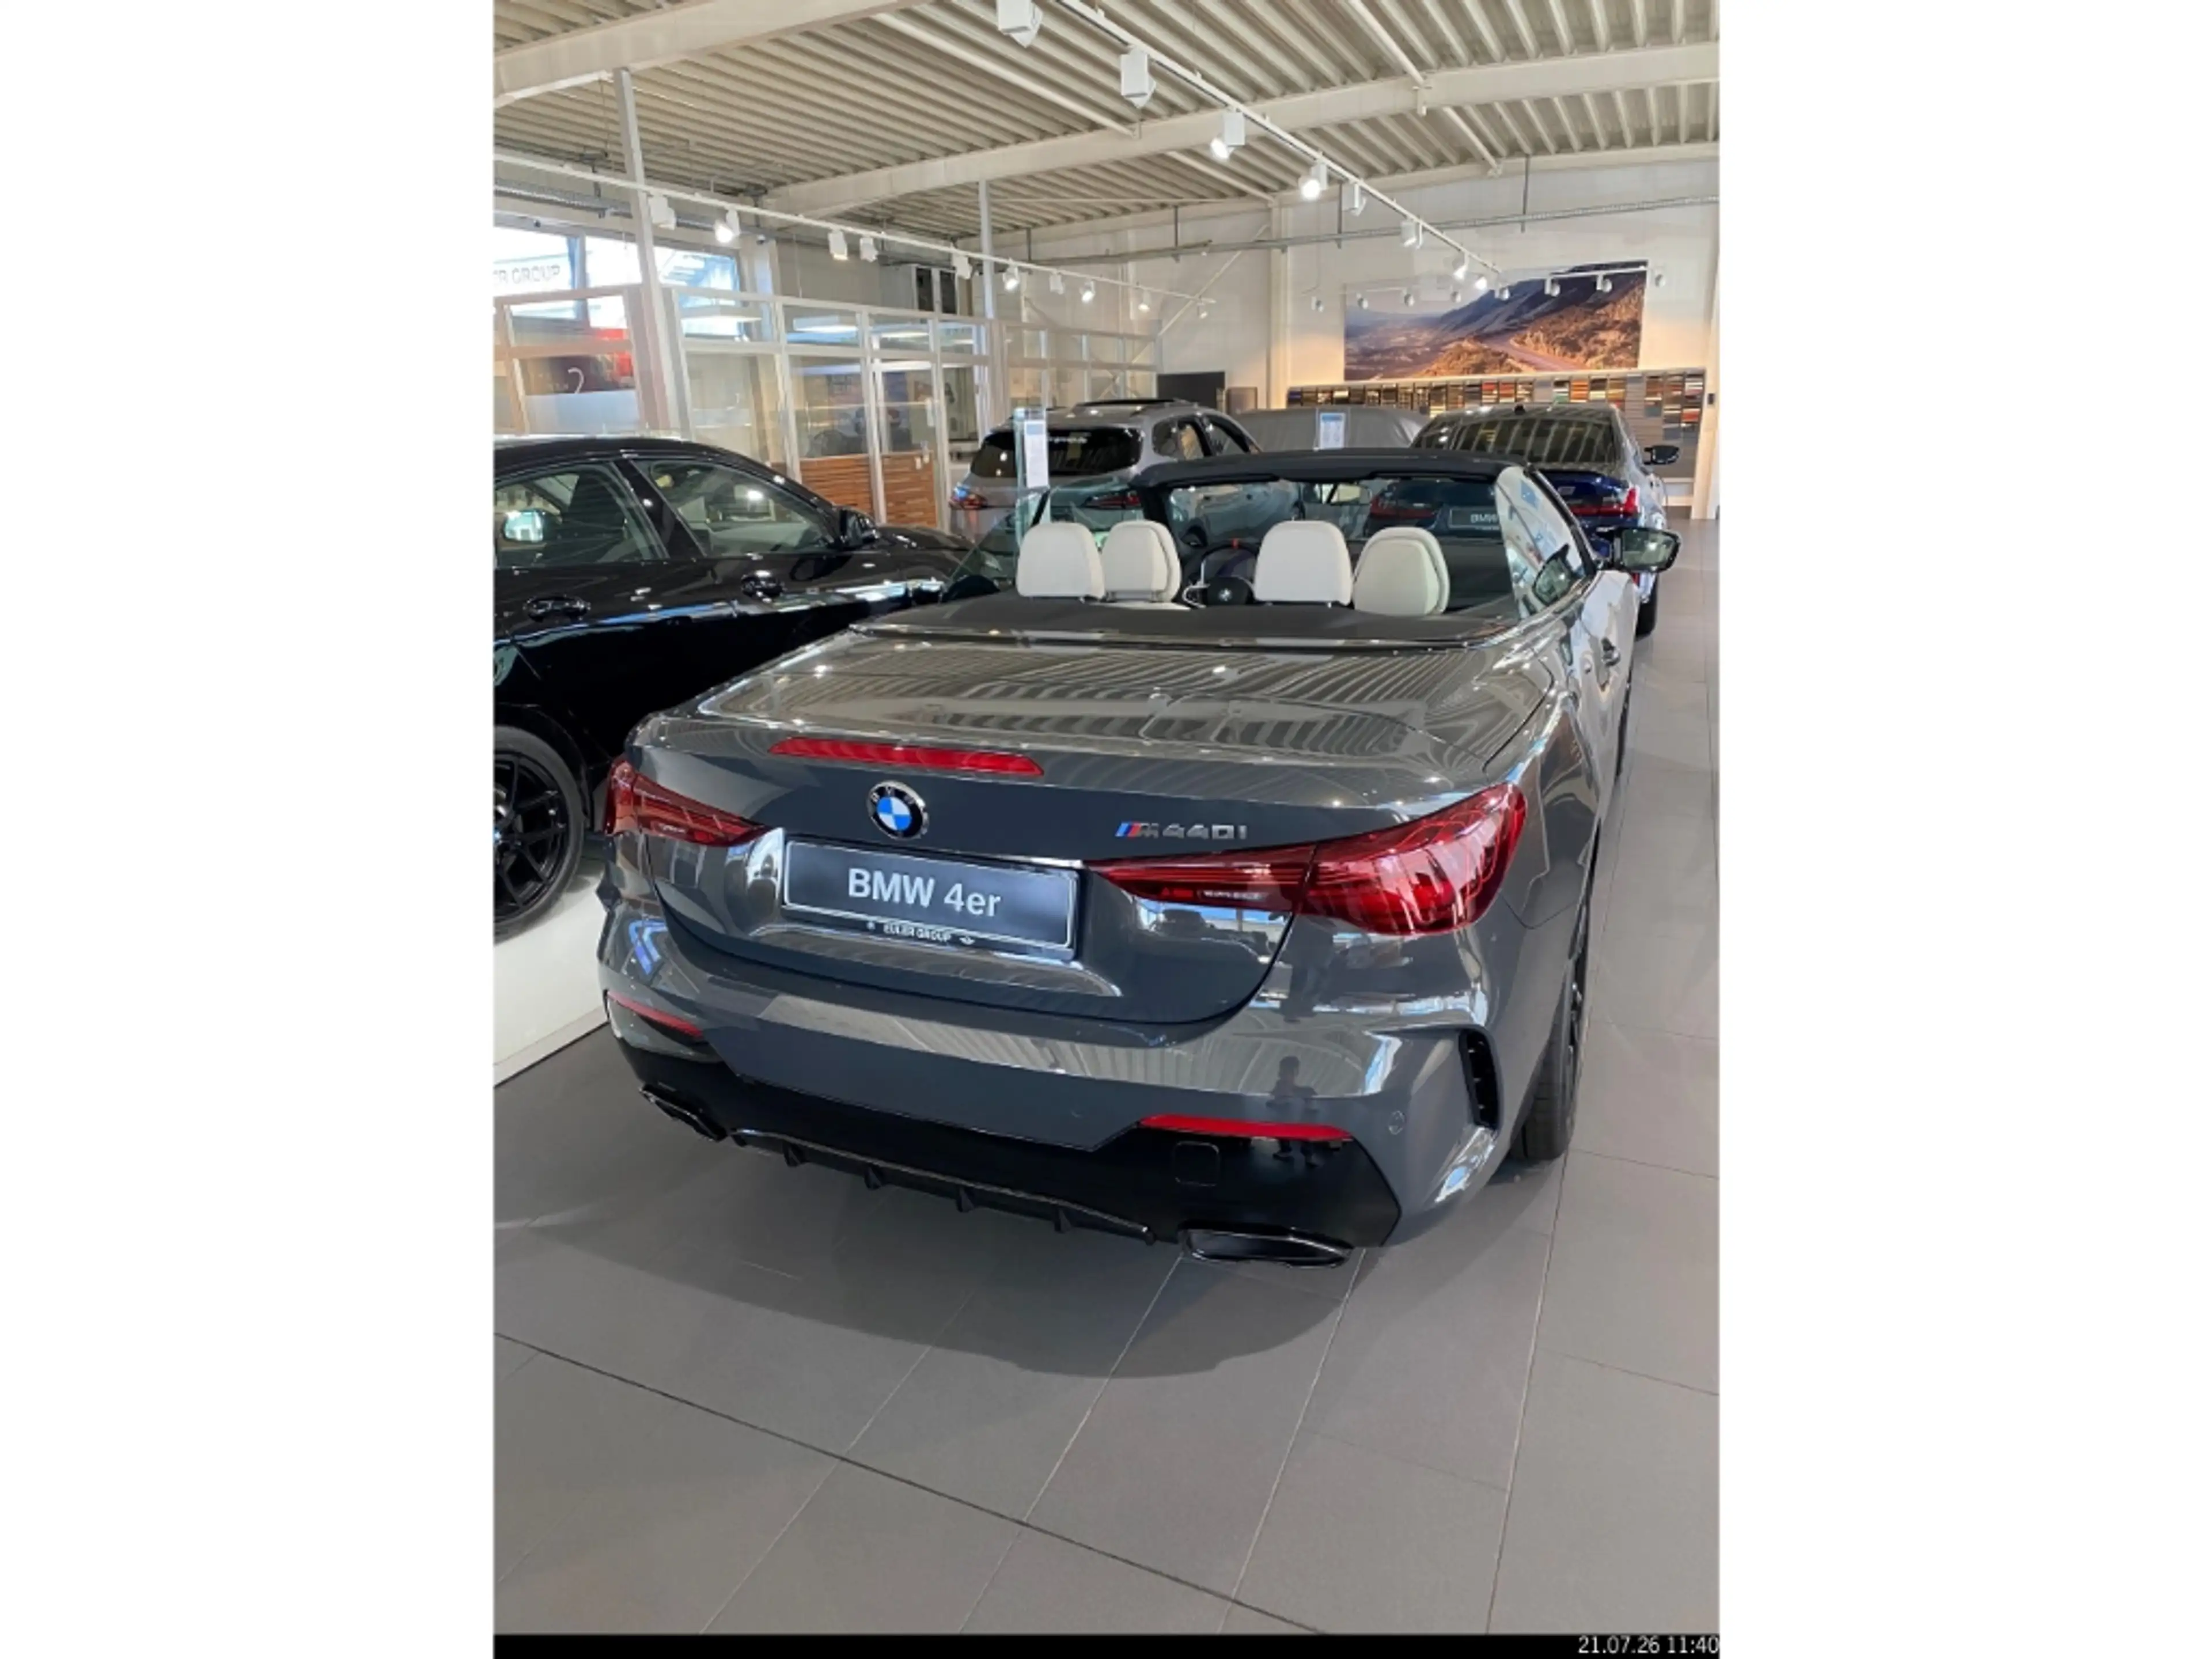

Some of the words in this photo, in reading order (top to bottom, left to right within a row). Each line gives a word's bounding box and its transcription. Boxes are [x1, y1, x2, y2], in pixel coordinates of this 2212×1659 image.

[512, 264, 560, 284] GROUP
[848, 867, 935, 908] BMW
[943, 882, 1001, 917] 4er
[883, 921, 915, 937] EULER
[916, 926, 952, 943] GROUP
